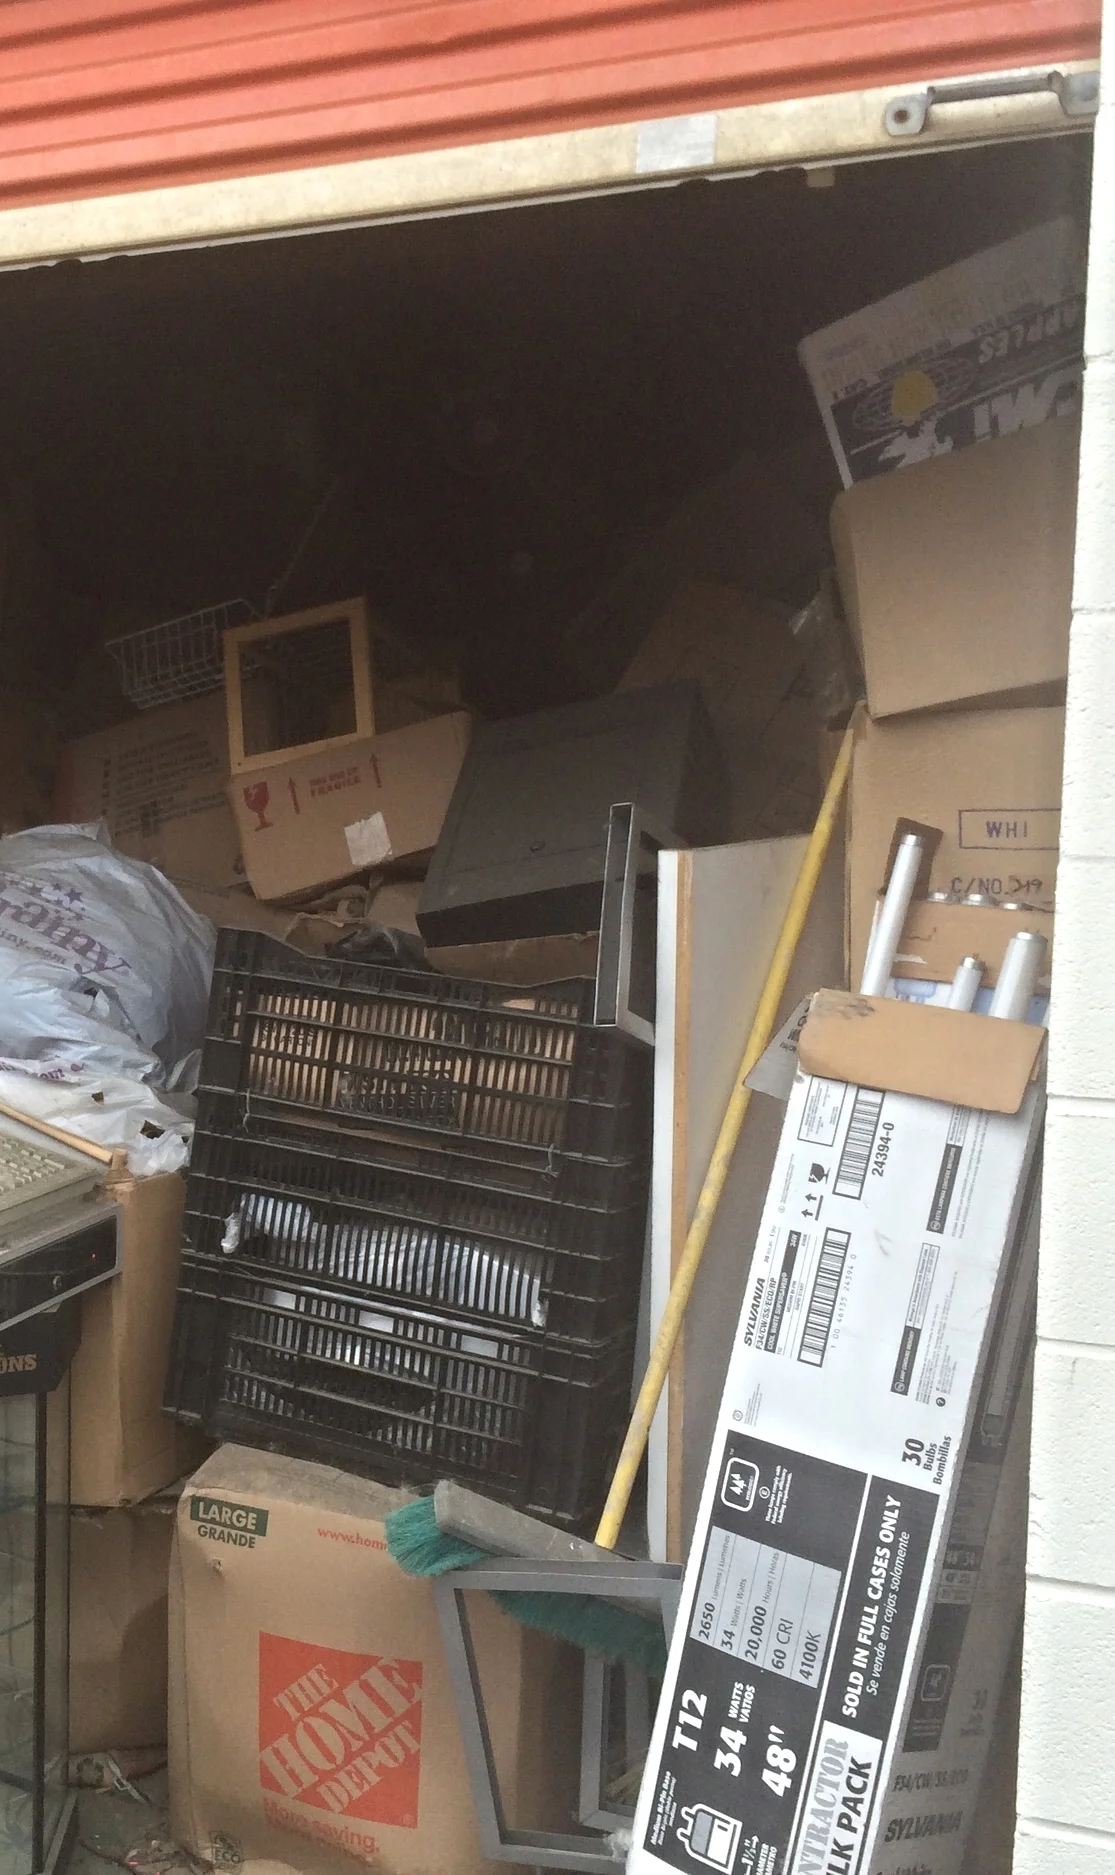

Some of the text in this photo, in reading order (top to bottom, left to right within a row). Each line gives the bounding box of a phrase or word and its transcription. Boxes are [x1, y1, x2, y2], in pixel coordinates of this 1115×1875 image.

[870, 1120, 895, 1177] 24394-0
[840, 1263, 855, 1291] 24394
[741, 1276, 767, 1346] SYLVANIA
[769, 1314, 780, 1333] WHITE
[832, 1327, 840, 1339] 00
[835, 1295, 847, 1323] 46135
[766, 1333, 775, 1350] COOL
[900, 1436, 925, 1466] 30
[922, 1441, 938, 1471] Bulbs
[931, 1434, 952, 1485] Bombillas
[197, 1500, 257, 1530] LARGE
[197, 1525, 256, 1550] GRANDE
[696, 1601, 717, 1639] 2650
[709, 1571, 723, 1600] Lumens
[720, 1577, 747, 1650] 34 Watts Watts
[743, 1605, 770, 1661] 20,000
[761, 1579, 774, 1603] Hours
[840, 1494, 902, 1718] SOLD IN FULL CASES ONLY
[864, 1530, 912, 1695] Se vende en cajas solamente
[770, 1617, 794, 1670] 60 CRI
[797, 1630, 822, 1680] 4100K
[273, 1663, 340, 1721] THE
[726, 1680, 745, 1719] WATTS
[737, 1683, 757, 1724] VATIOS
[259, 1657, 423, 1799] HOME
[670, 1687, 709, 1754] T12
[315, 1720, 422, 1814] DEPOT
[711, 1725, 749, 1777] 34
[755, 1724, 803, 1798] 48"
[834, 1755, 874, 1833] PACK
[312, 1820, 380, 1854] saving.
[885, 1812, 962, 1842] SYLVANIA
